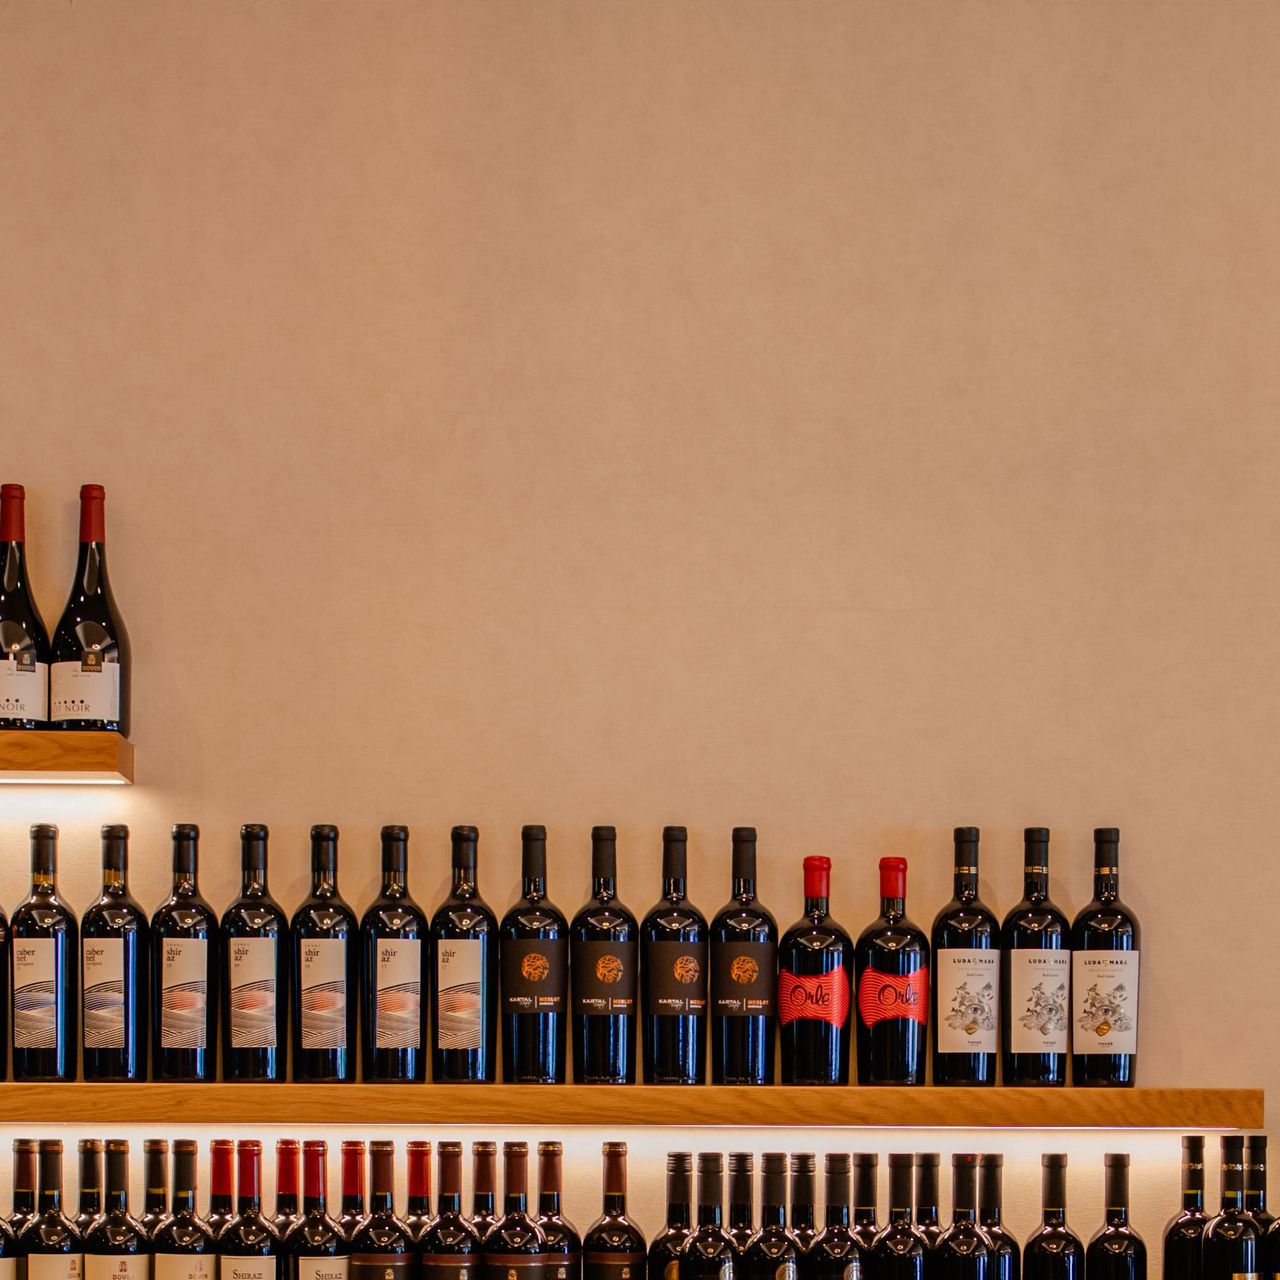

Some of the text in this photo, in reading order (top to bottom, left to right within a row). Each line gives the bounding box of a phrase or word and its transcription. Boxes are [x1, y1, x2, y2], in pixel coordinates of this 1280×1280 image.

[0, 703, 26, 711] NOIR
[65, 704, 90, 712] NOIR
[166, 948, 182, 956] shir
[234, 947, 249, 956] shir
[304, 948, 320, 957] shir
[381, 949, 397, 957] shir
[790, 984, 830, 1007] Orle
[232, 1269, 263, 1280] SHIRAZ
[315, 1269, 343, 1280] SHIRAZ
